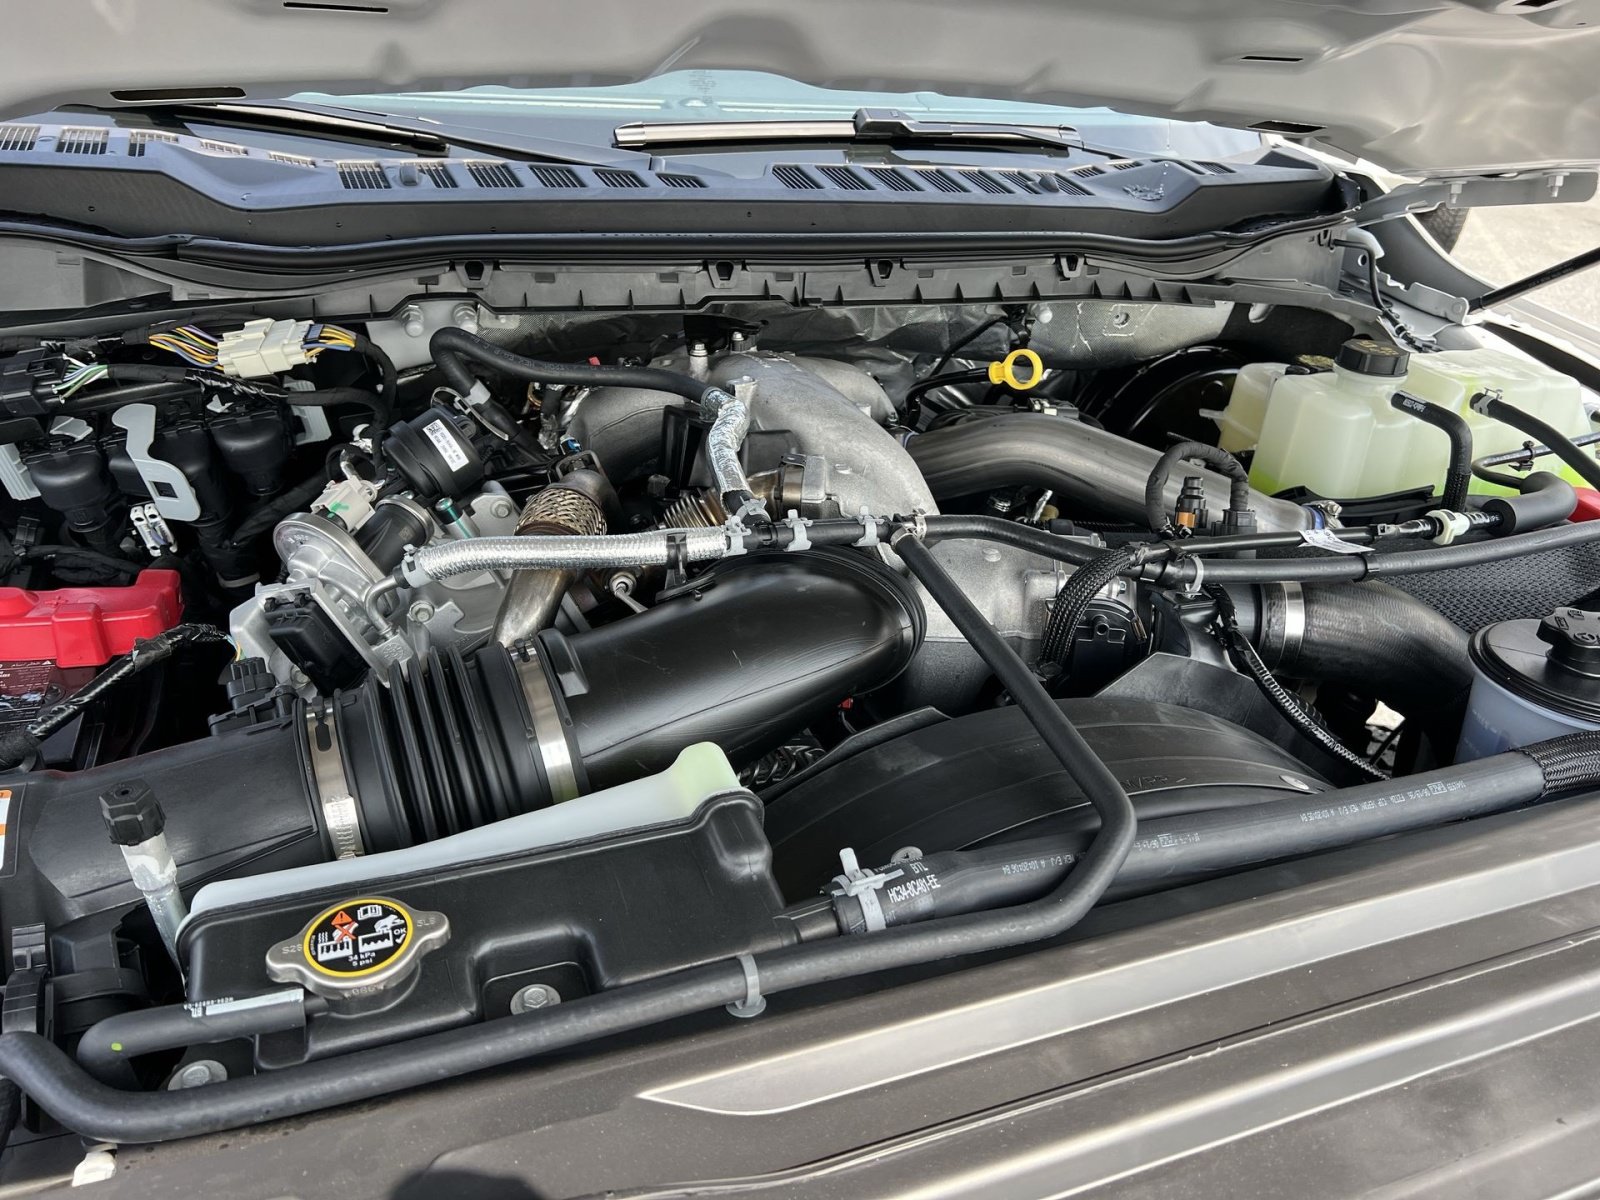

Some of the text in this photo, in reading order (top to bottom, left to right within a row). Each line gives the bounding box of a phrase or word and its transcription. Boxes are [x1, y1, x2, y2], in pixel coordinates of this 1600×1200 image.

[910, 861, 929, 873] BTL
[393, 927, 407, 936] OK
[348, 951, 376, 962] 34 kPa
[360, 957, 373, 967] psi
